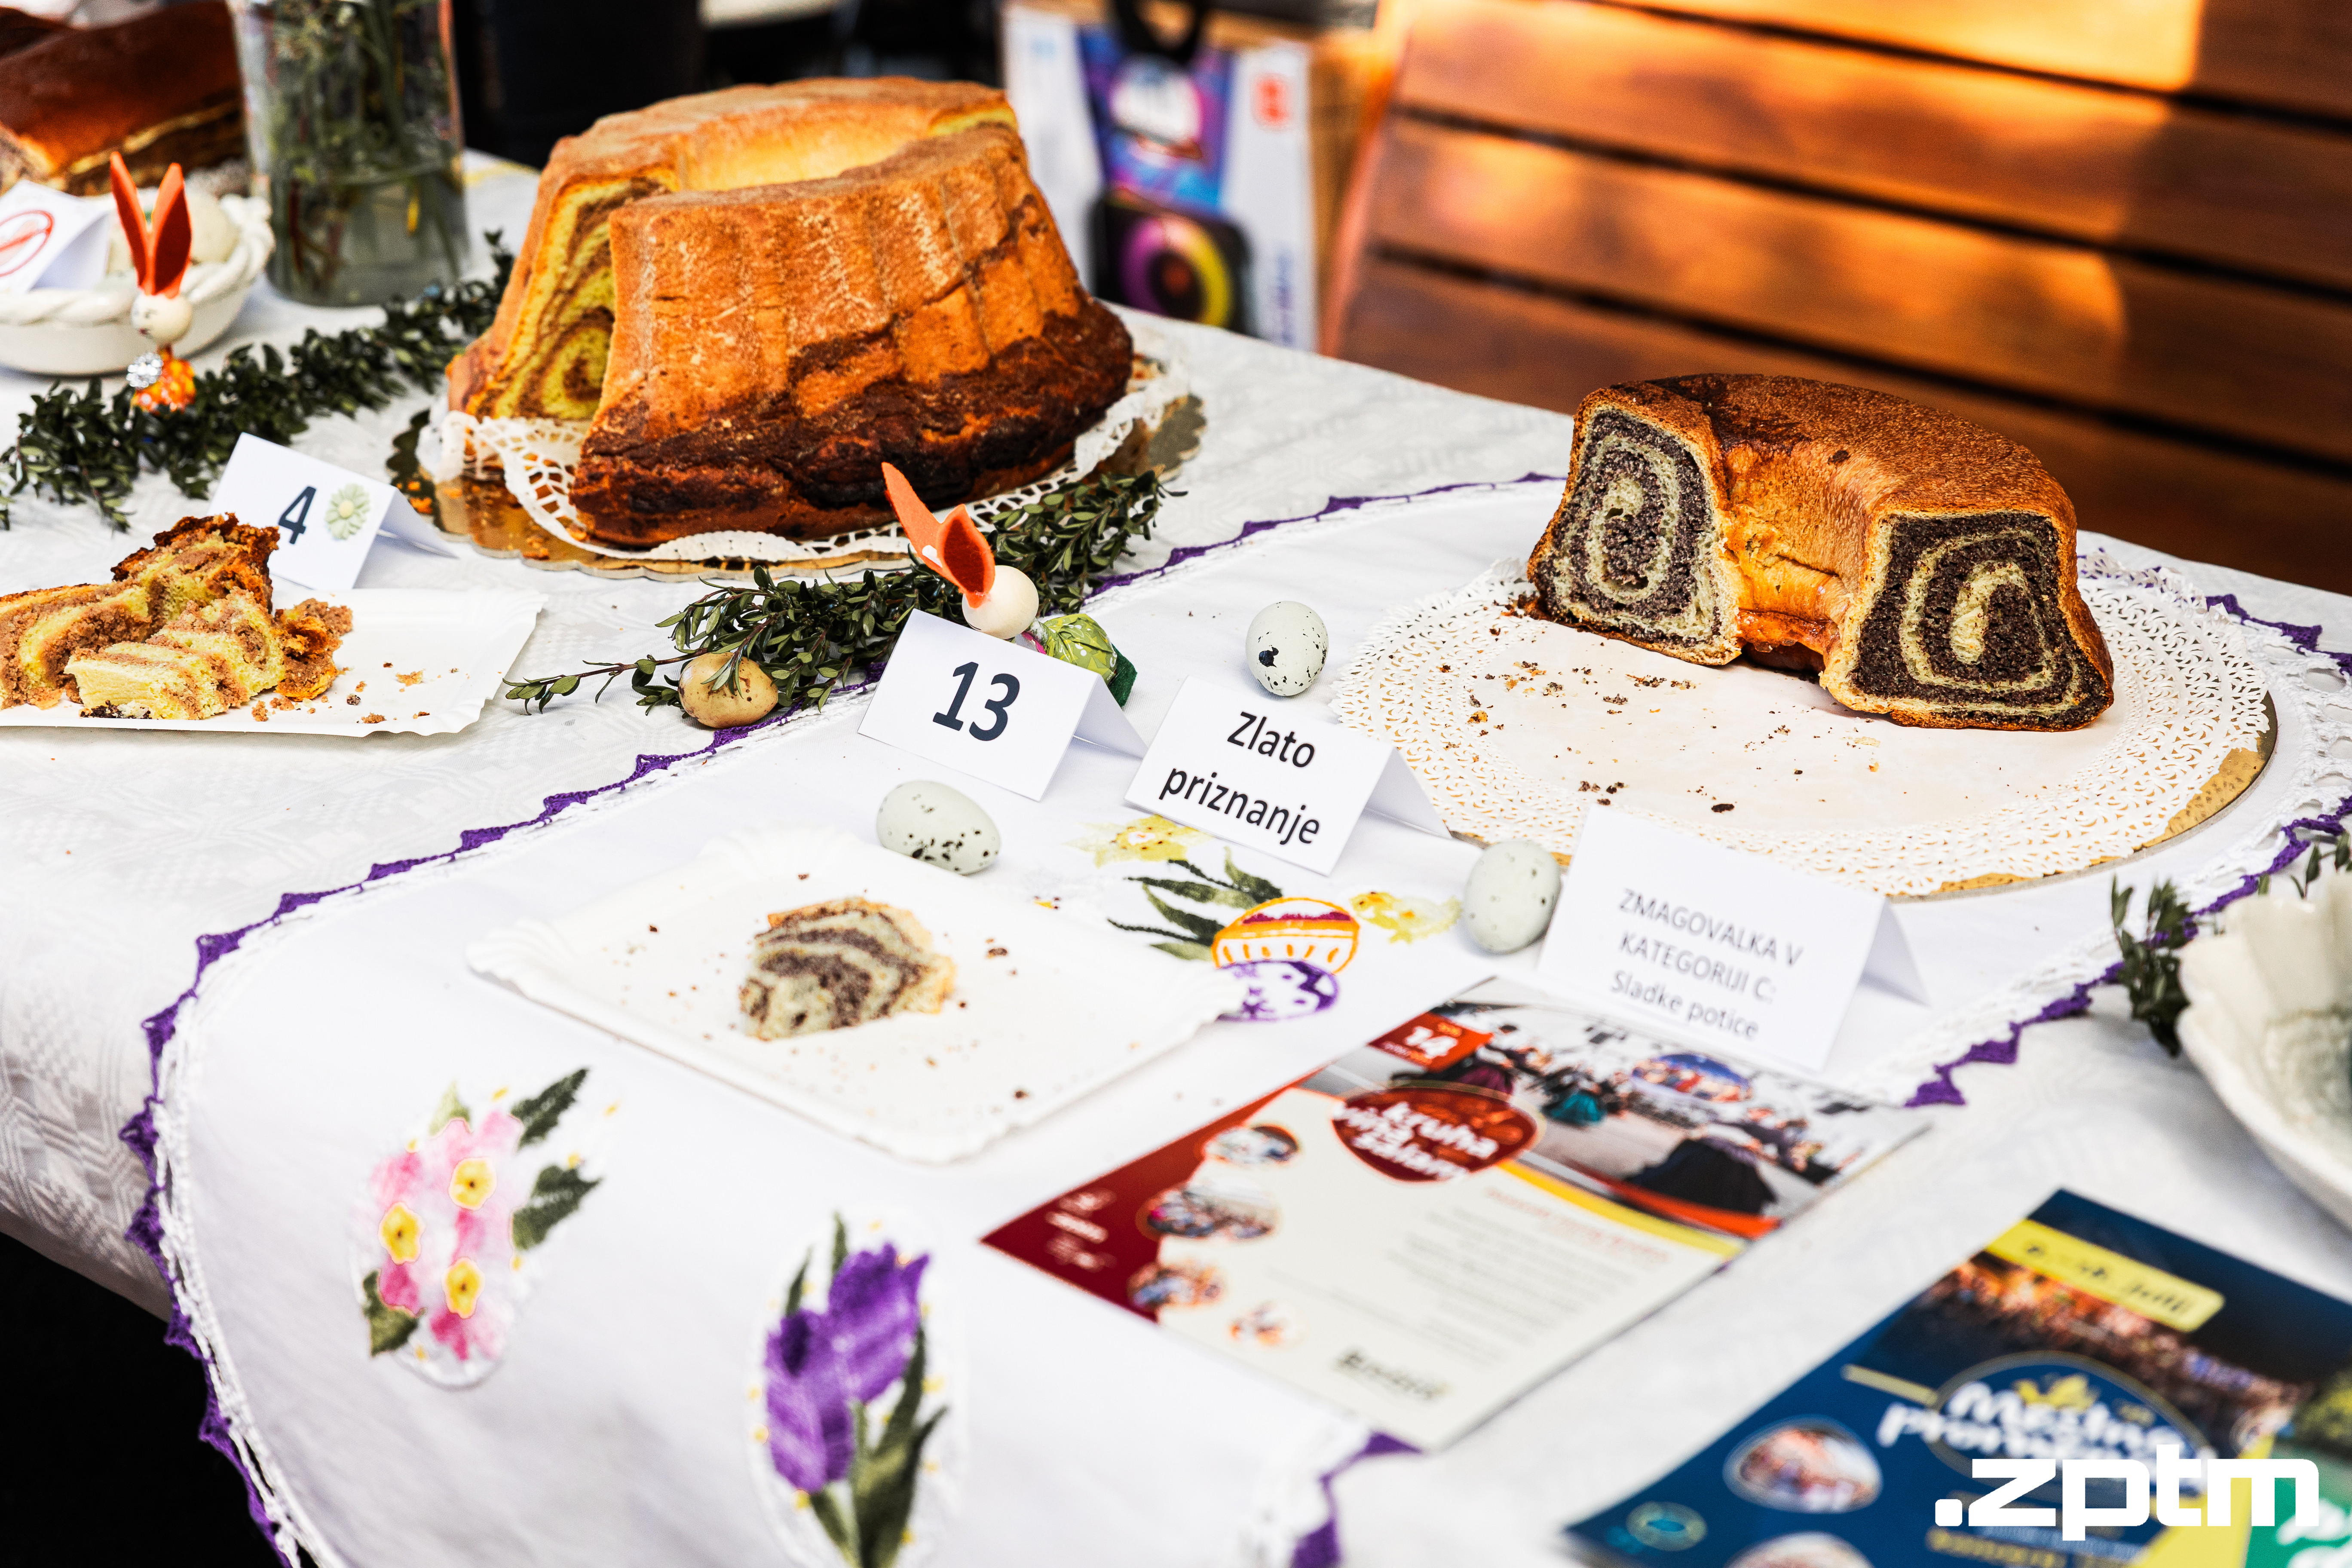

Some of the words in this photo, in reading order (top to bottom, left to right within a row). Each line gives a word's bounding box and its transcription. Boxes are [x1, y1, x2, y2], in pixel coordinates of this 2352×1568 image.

[278, 486, 317, 545] 4
[931, 661, 1021, 742] 13
[1226, 711, 1316, 769] Zlato
[1158, 768, 1320, 845] priznanje
[1618, 888, 1777, 961] ZMAGOVALKA
[1785, 943, 1804, 968] V
[1618, 931, 1749, 992] KATEGORIJI
[1611, 970, 1683, 1013] Sladke
[1686, 1001, 1759, 1040] potice
[1404, 1025, 1458, 1059] 14
